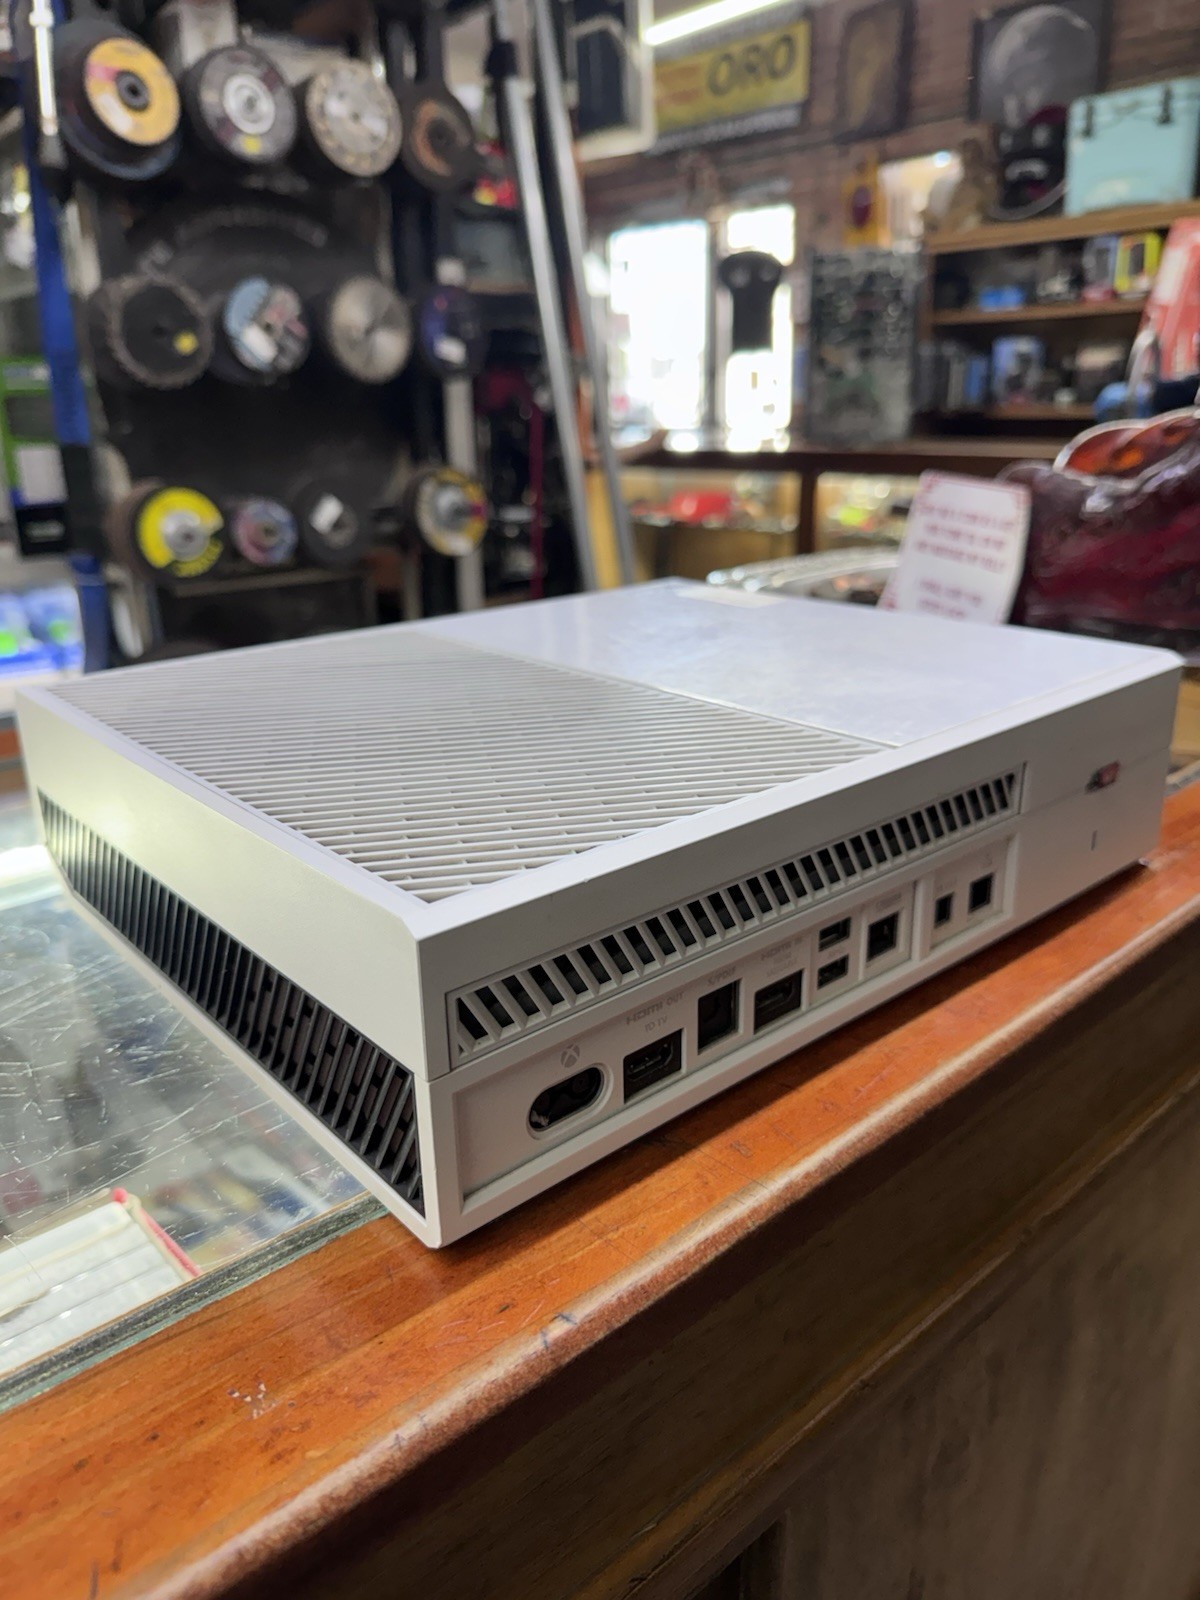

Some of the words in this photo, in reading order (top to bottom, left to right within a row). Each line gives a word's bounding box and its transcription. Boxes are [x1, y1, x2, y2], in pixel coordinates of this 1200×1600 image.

[707, 33, 797, 97] ORO
[625, 1000, 664, 1025] HDMI
[666, 990, 685, 1006] OUT
